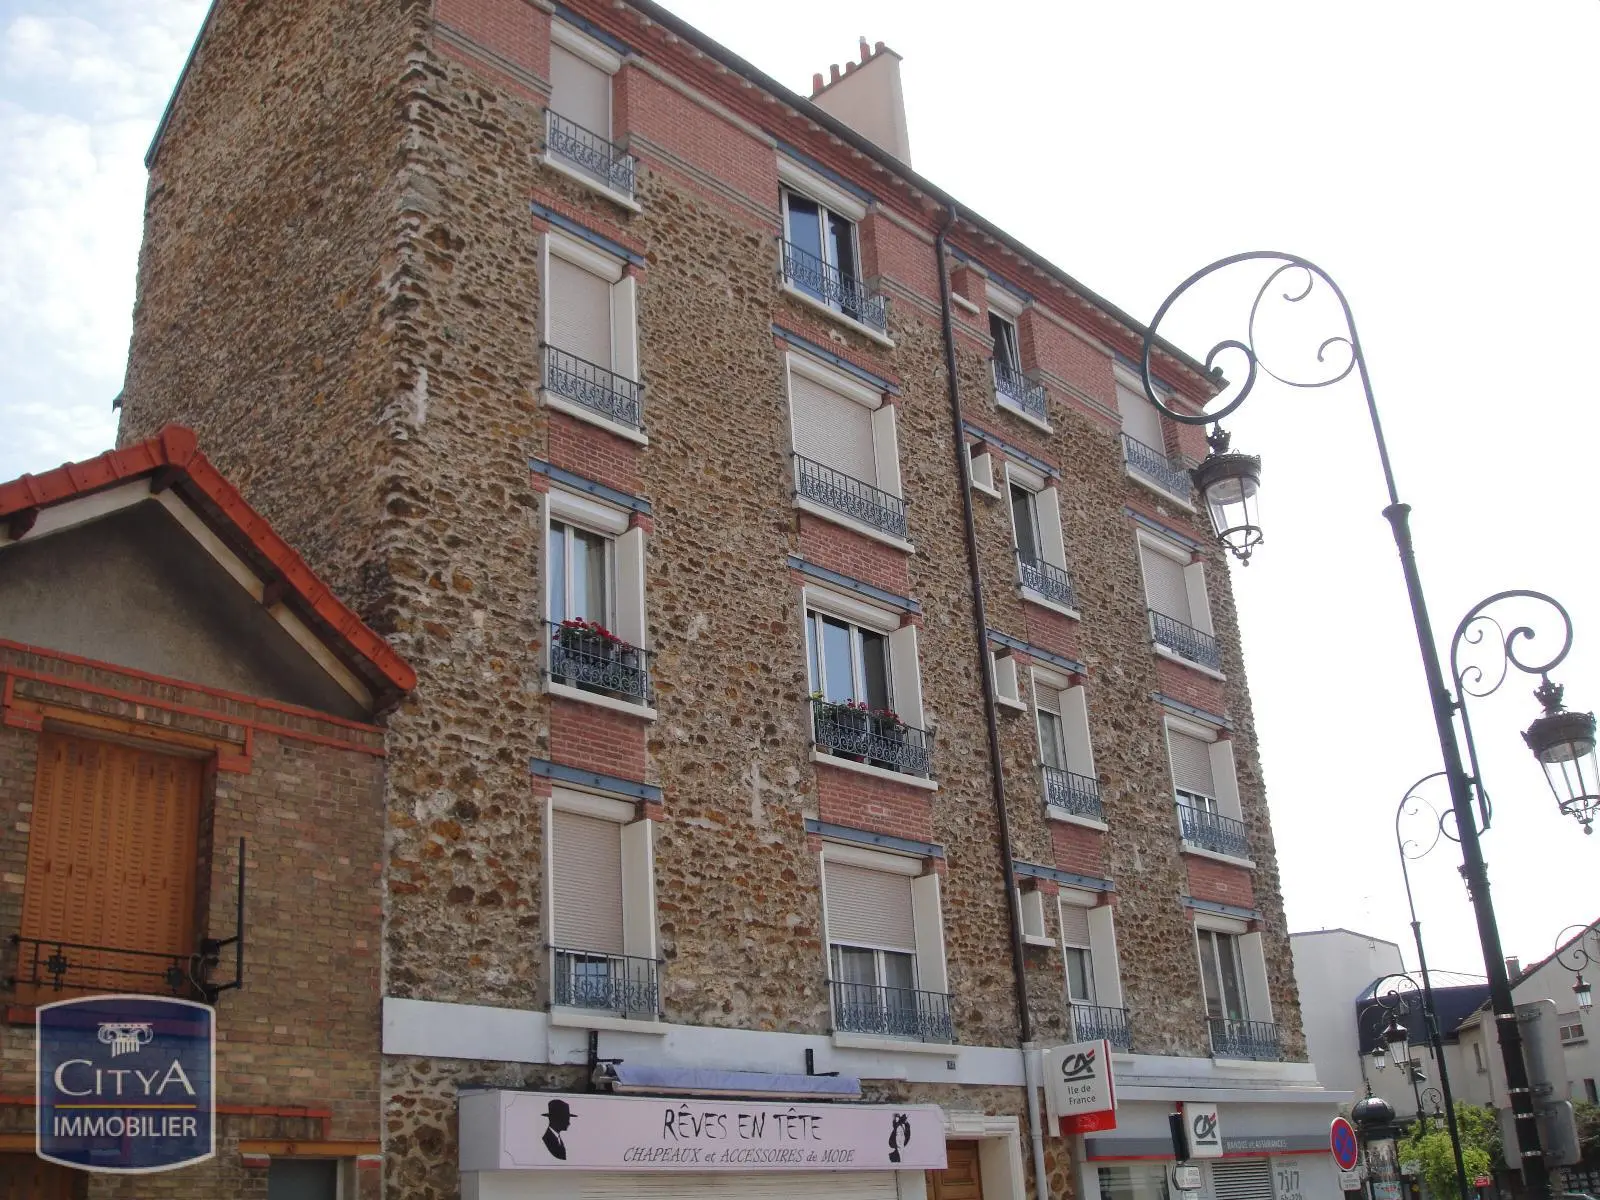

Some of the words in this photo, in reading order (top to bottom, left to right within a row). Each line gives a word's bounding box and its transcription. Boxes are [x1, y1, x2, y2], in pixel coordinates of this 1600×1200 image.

[1080, 1084, 1091, 1093] de
[1069, 1095, 1097, 1105] France
[663, 1103, 728, 1141] RÊVES
[738, 1112, 766, 1140] EN
[773, 1107, 823, 1140] TÊTE
[623, 1147, 702, 1162] CHAPEAUX
[704, 1151, 716, 1162] et
[720, 1149, 803, 1163] ACCESSOIRES
[806, 1151, 818, 1162] de
[821, 1149, 855, 1162] MODE
